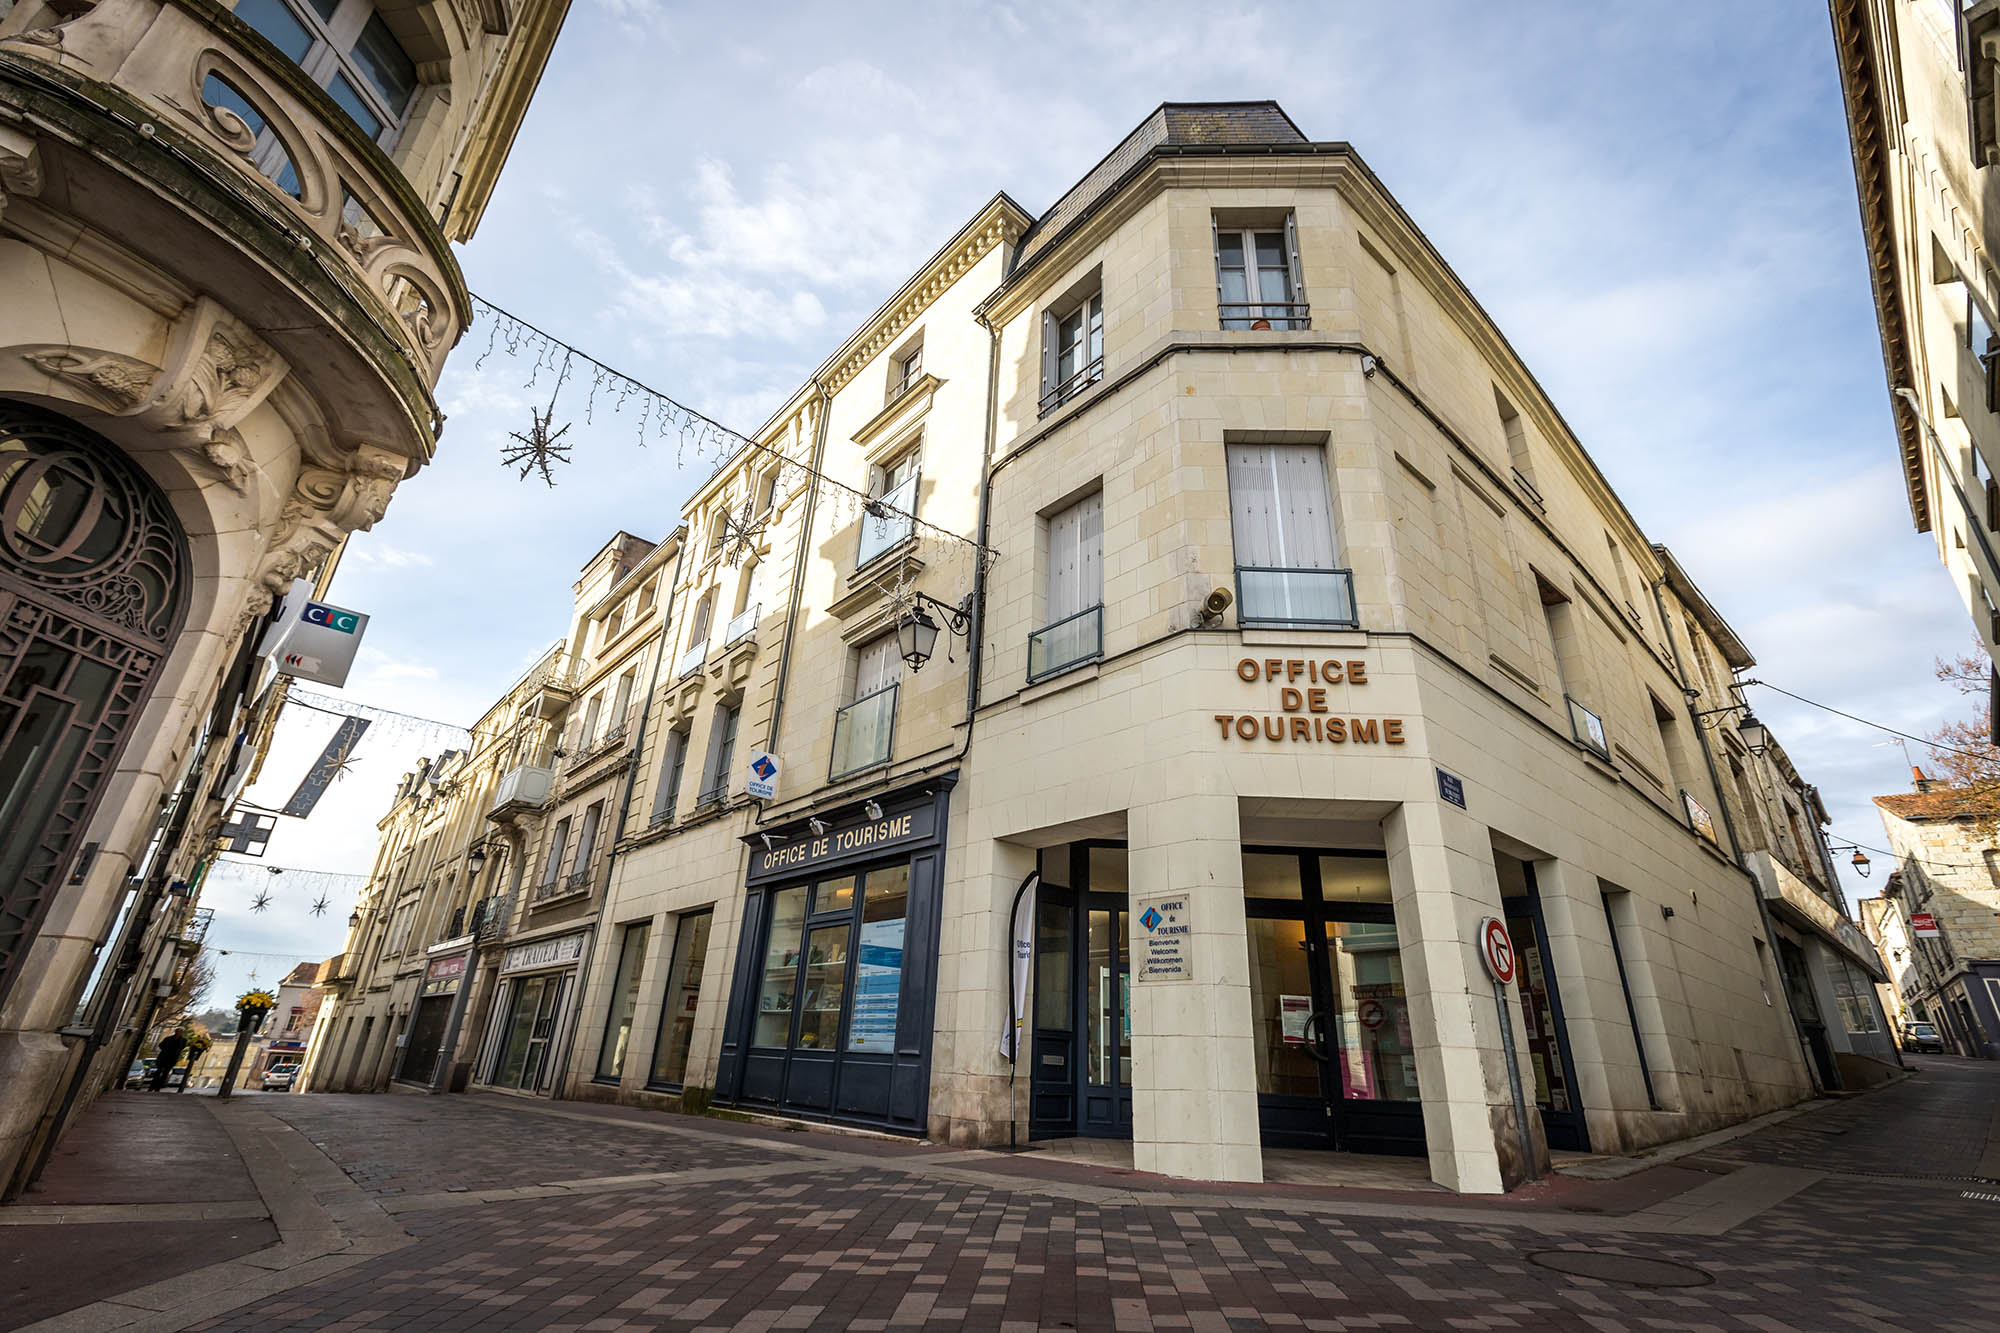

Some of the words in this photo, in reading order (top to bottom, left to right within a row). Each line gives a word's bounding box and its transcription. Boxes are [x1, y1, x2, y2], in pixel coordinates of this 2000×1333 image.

[308, 608, 353, 630] CIC
[1237, 658, 1368, 684] OFFICE
[1281, 687, 1328, 712] DE
[1215, 715, 1405, 744] TOURISME
[749, 781, 766, 789] OFFICE
[749, 786, 772, 796] TOURISME
[764, 844, 806, 869] OFFICE
[812, 837, 829, 857] DE
[837, 815, 912, 850] TOURISME
[1161, 902, 1183, 911] OFFICE
[1158, 925, 1188, 935] TOURISME
[1147, 957, 1183, 965] Willkommen
[1148, 966, 1182, 974] Bienvenida
